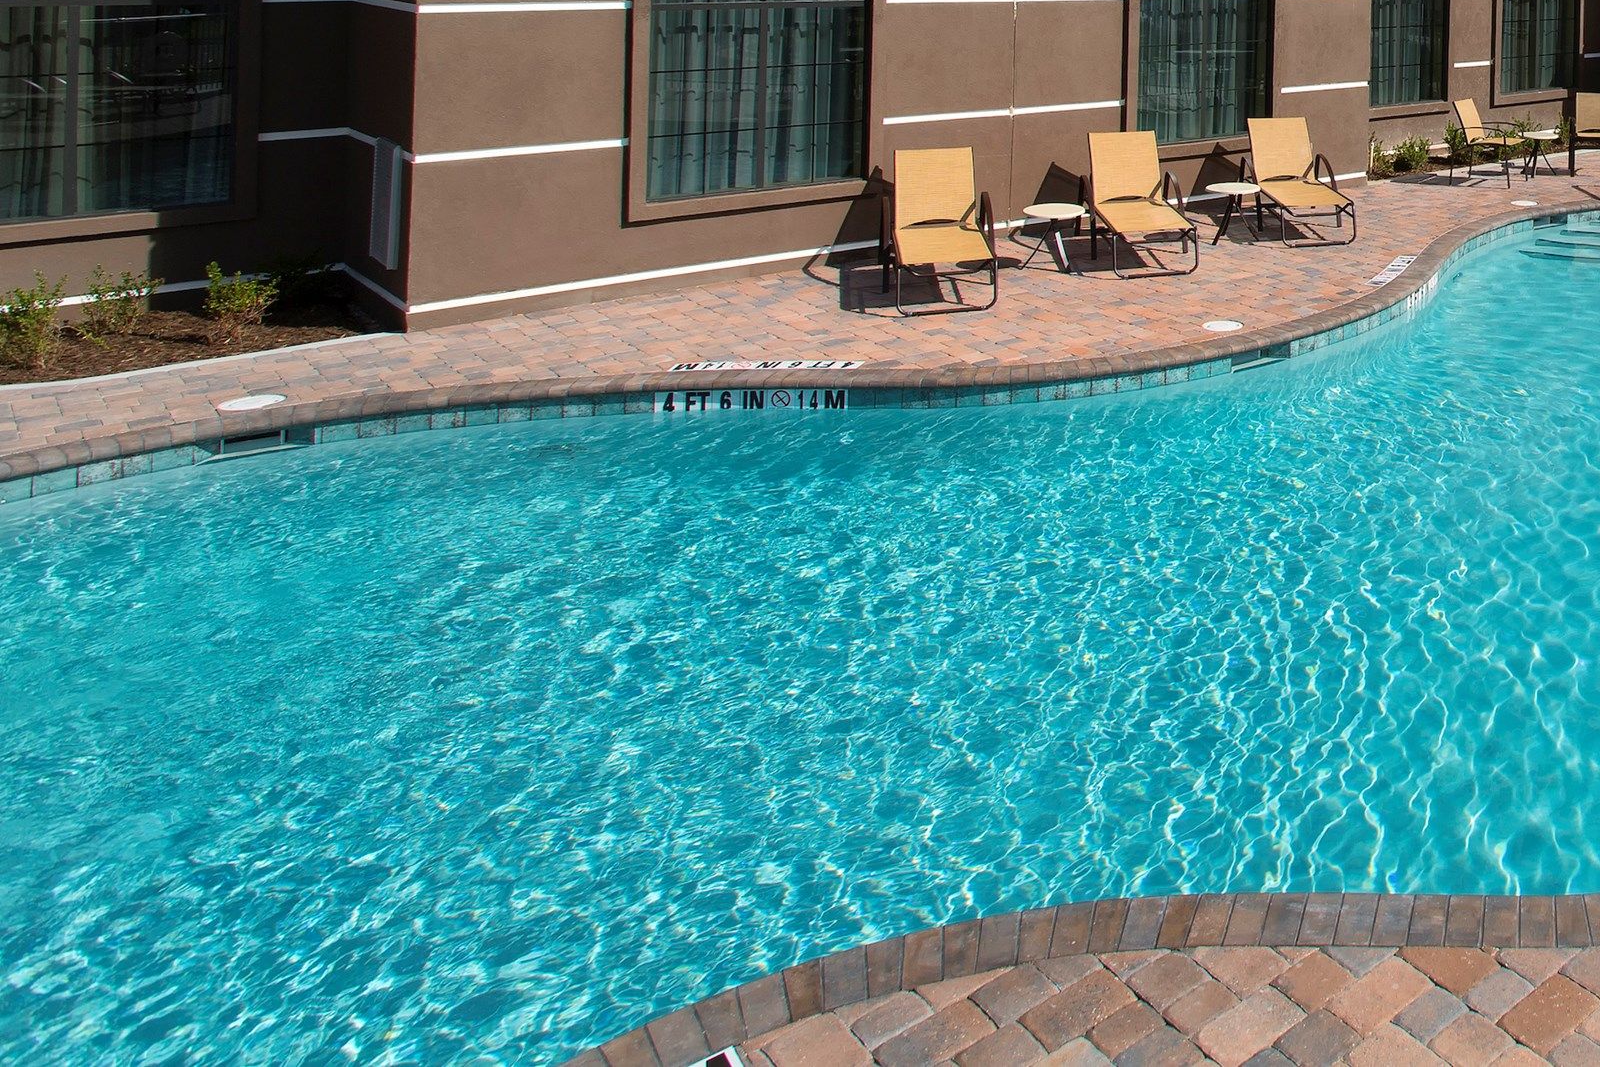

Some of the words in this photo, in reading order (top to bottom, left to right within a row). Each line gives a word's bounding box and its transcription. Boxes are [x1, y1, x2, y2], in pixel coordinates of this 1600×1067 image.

[675, 363, 698, 371] M
[663, 392, 675, 412] 4
[685, 392, 710, 411] FT
[720, 391, 732, 410] 6
[743, 390, 765, 410] IN
[798, 390, 818, 410] 14
[824, 390, 845, 410] M
